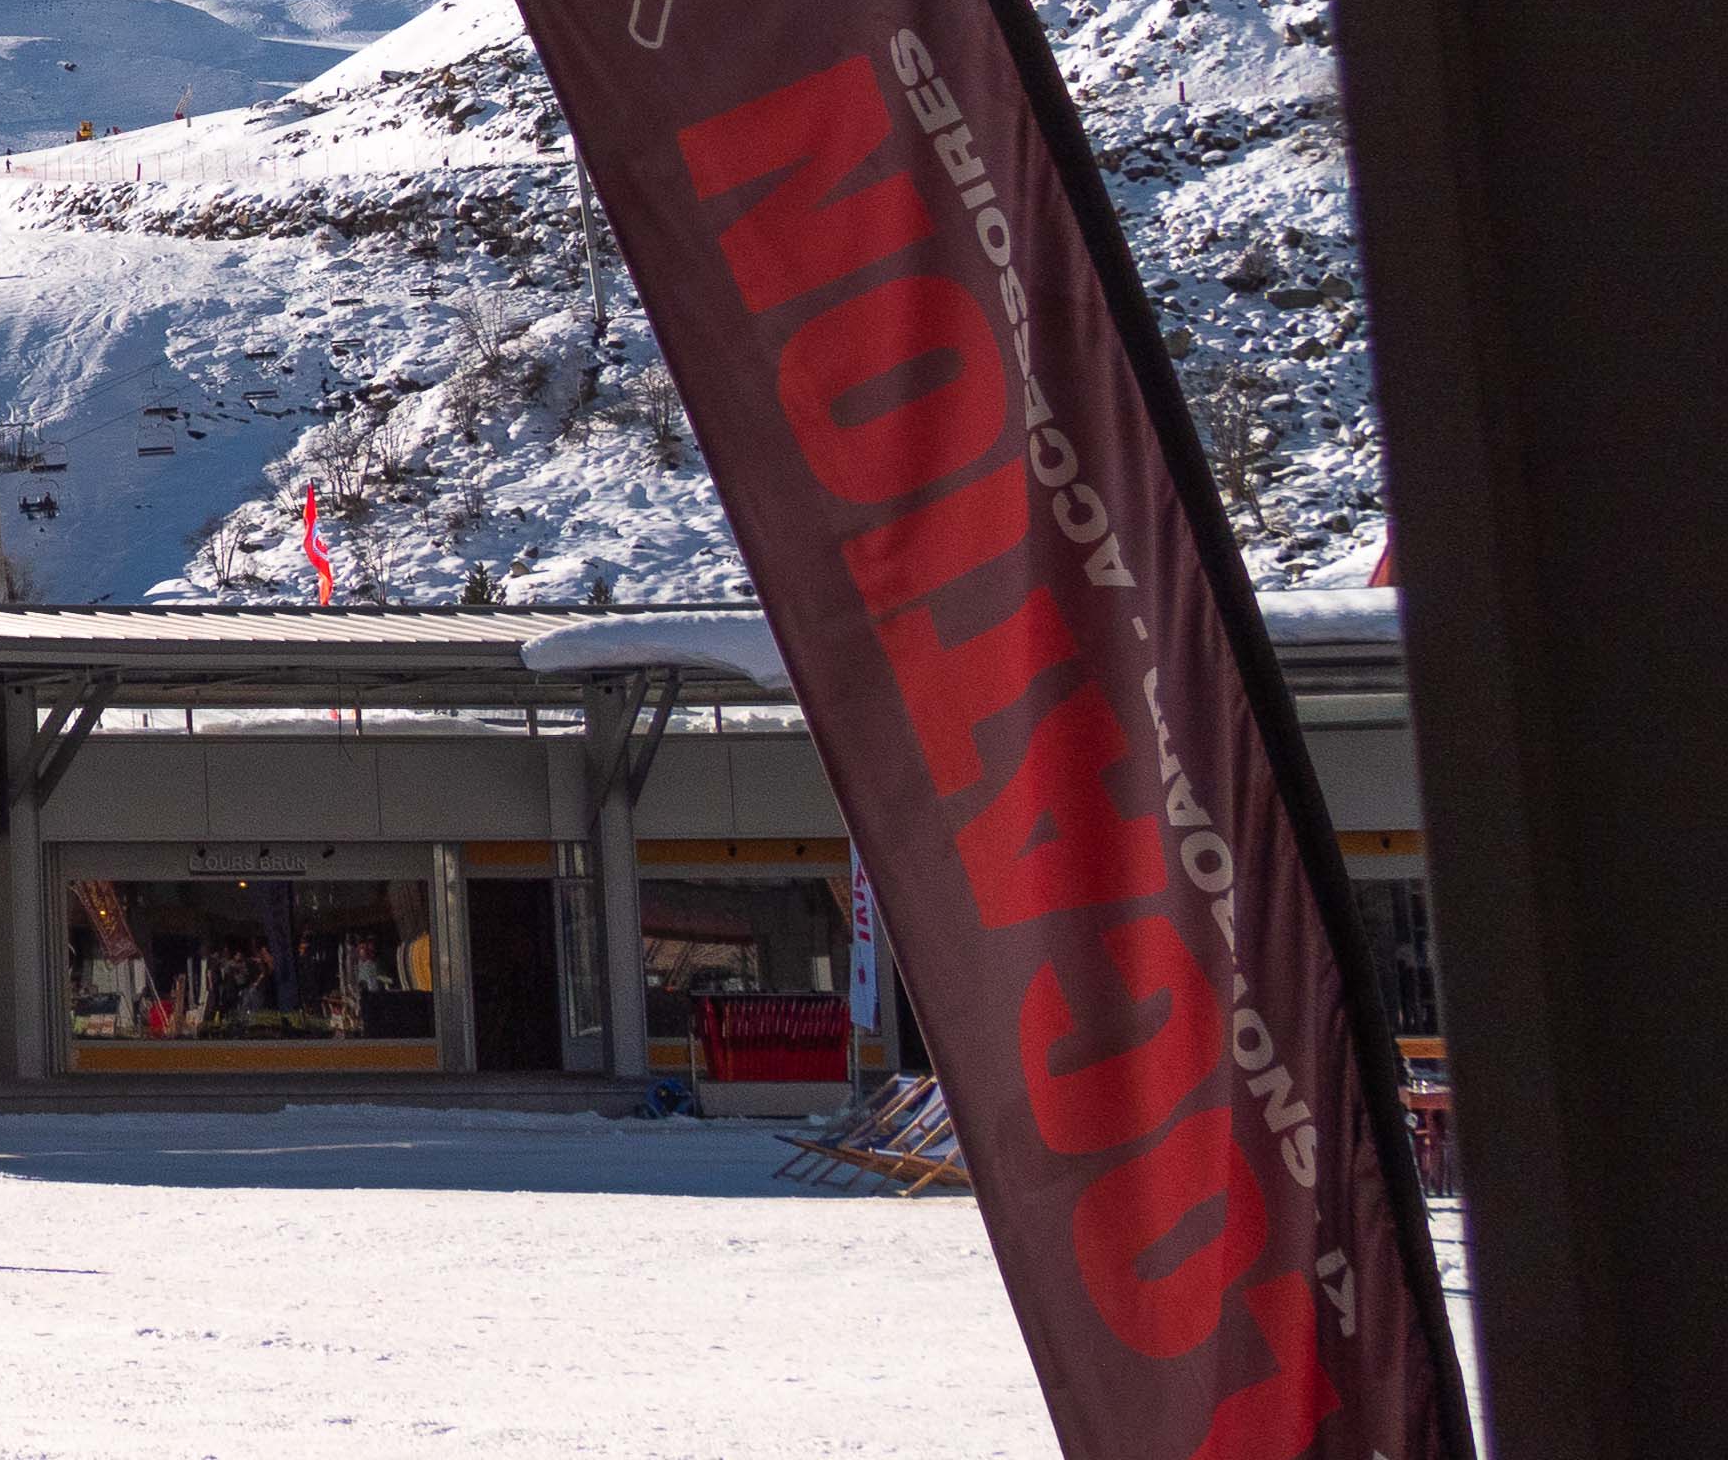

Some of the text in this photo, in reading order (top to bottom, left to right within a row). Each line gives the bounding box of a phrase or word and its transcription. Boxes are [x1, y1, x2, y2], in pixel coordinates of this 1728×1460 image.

[890, 28, 1137, 588] ACCESSOIRES
[676, 53, 1342, 1460] LOCATION
[1142, 666, 1317, 1188] SNOOAR
